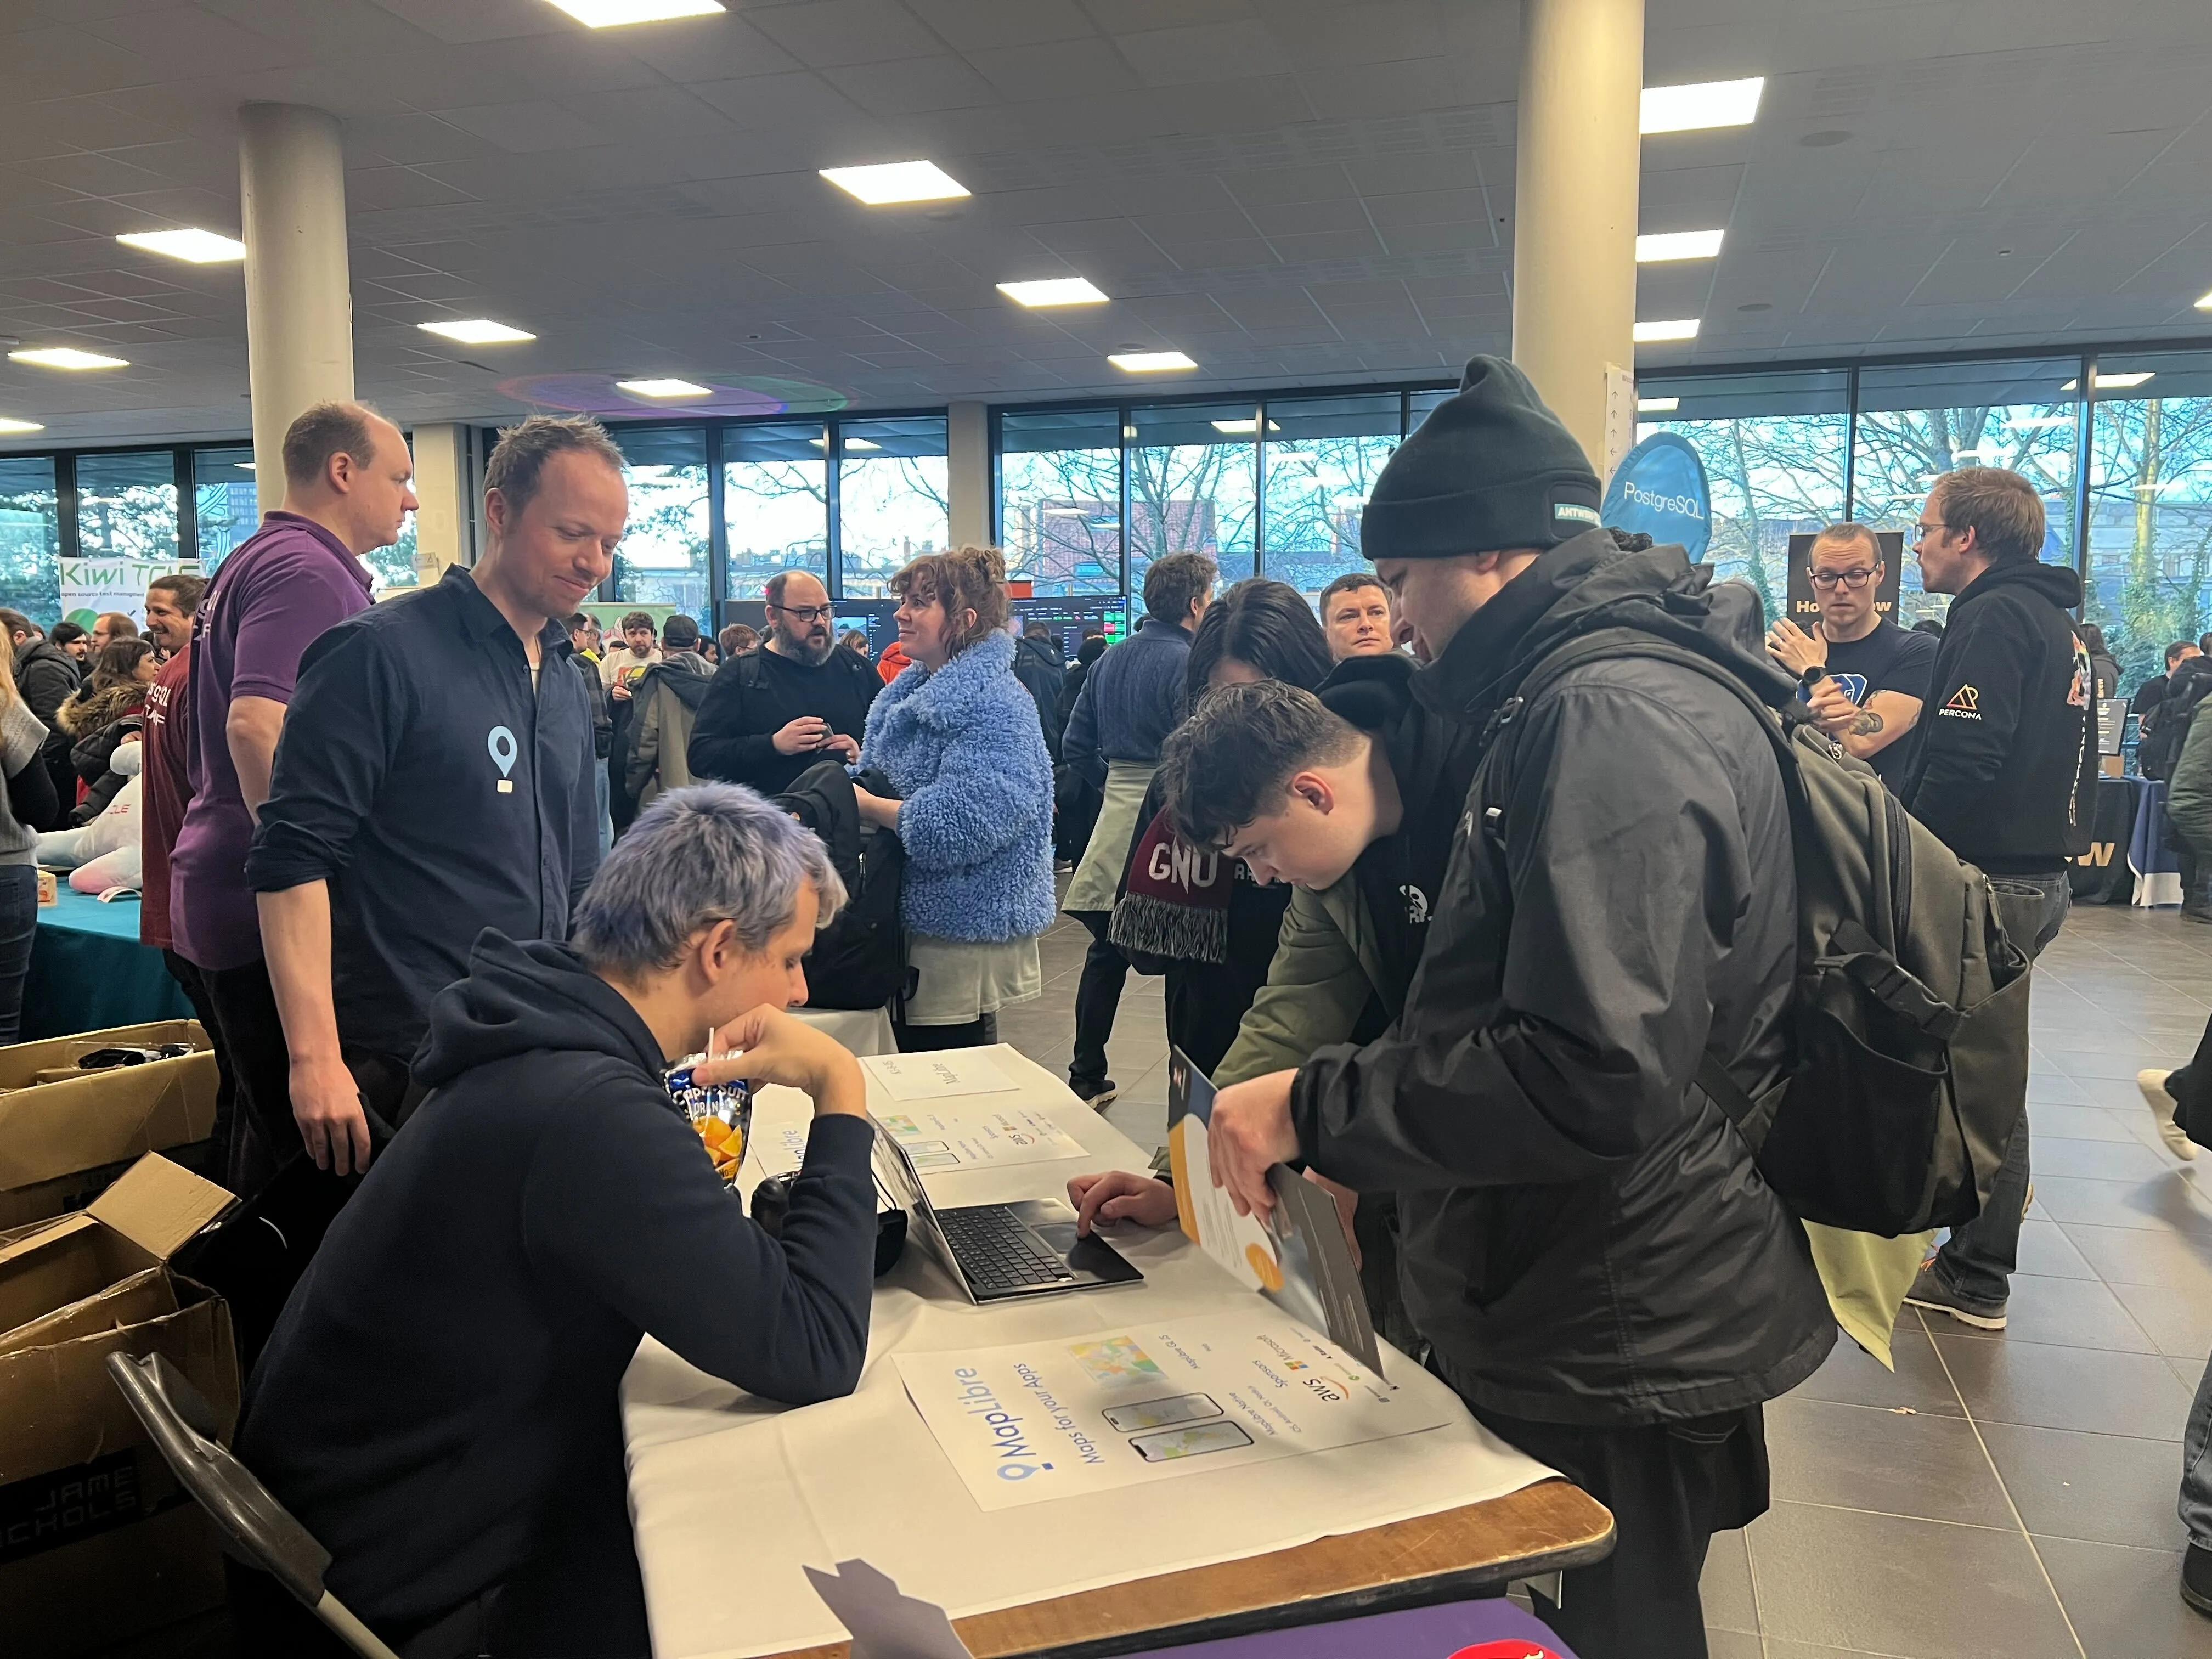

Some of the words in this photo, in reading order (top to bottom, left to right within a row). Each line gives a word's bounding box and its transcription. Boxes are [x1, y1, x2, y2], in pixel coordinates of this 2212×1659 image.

[1623, 481, 1705, 520] PostgreSQL
[60, 561, 124, 586] Kiwi
[1939, 709, 1982, 720] PERCONA
[1148, 835, 1218, 894] GNU
[1256, 1334, 1294, 1361] Microsoft
[1013, 1363, 1043, 1388] Apps
[1252, 1359, 1289, 1388] Sponsors
[1034, 1390, 1068, 1413] your
[1302, 1378, 1340, 1402] aws
[954, 1368, 1036, 1458] MapLibre
[1054, 1415, 1076, 1431] for
[1069, 1431, 1105, 1464] Maps
